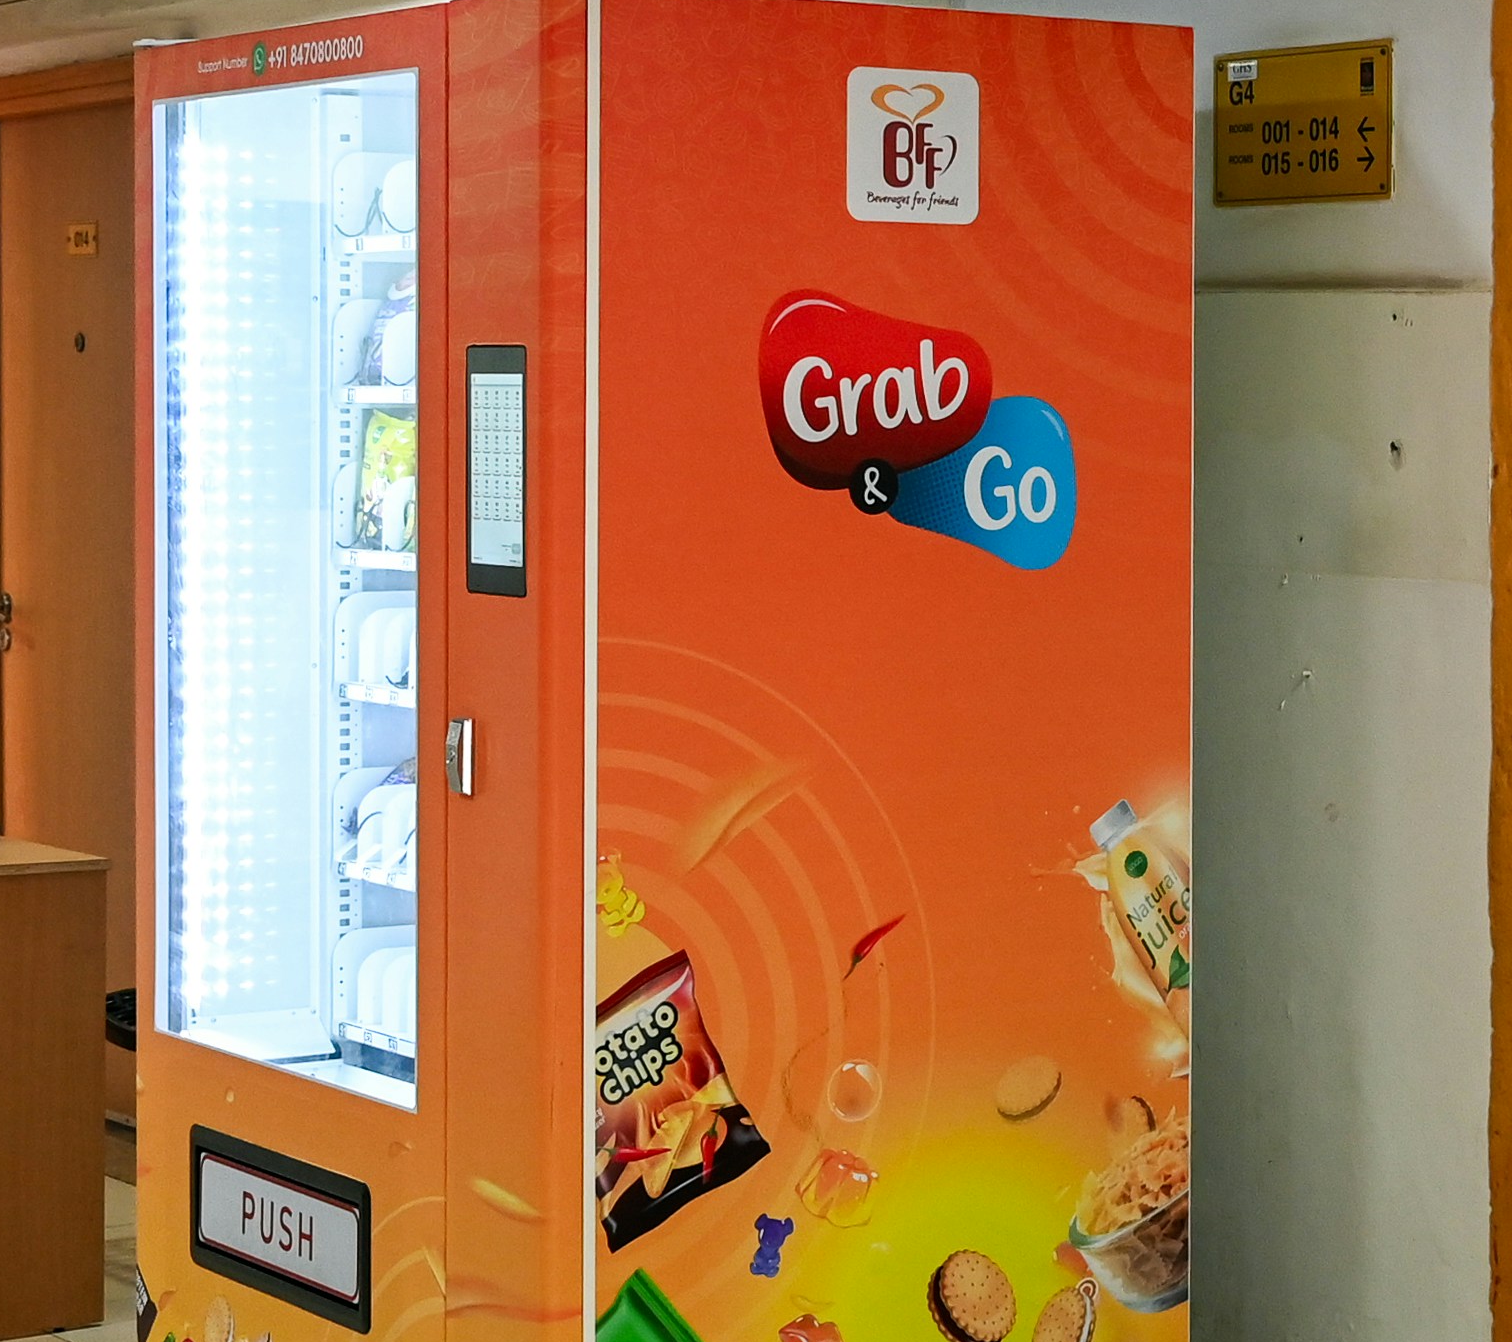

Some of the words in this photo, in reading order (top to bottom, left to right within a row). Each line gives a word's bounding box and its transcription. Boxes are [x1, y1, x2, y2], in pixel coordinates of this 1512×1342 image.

[268, 46, 287, 69] +91
[290, 35, 363, 67] 8470800800
[1229, 81, 1255, 106] G4
[882, 120, 944, 190] BFF
[1261, 120, 1290, 144] 001
[1309, 116, 1339, 142] 014
[1261, 151, 1290, 175] 015
[1309, 148, 1339, 173] 016
[911, 190, 927, 211] for
[927, 191, 959, 211] friends
[782, 338, 970, 443] Grab
[862, 467, 887, 507] &
[964, 446, 1057, 531] Go
[1126, 866, 1179, 930] Natural
[1140, 887, 1190, 970] juice
[602, 1036, 680, 1102] chips
[241, 1191, 315, 1261] PUSH
